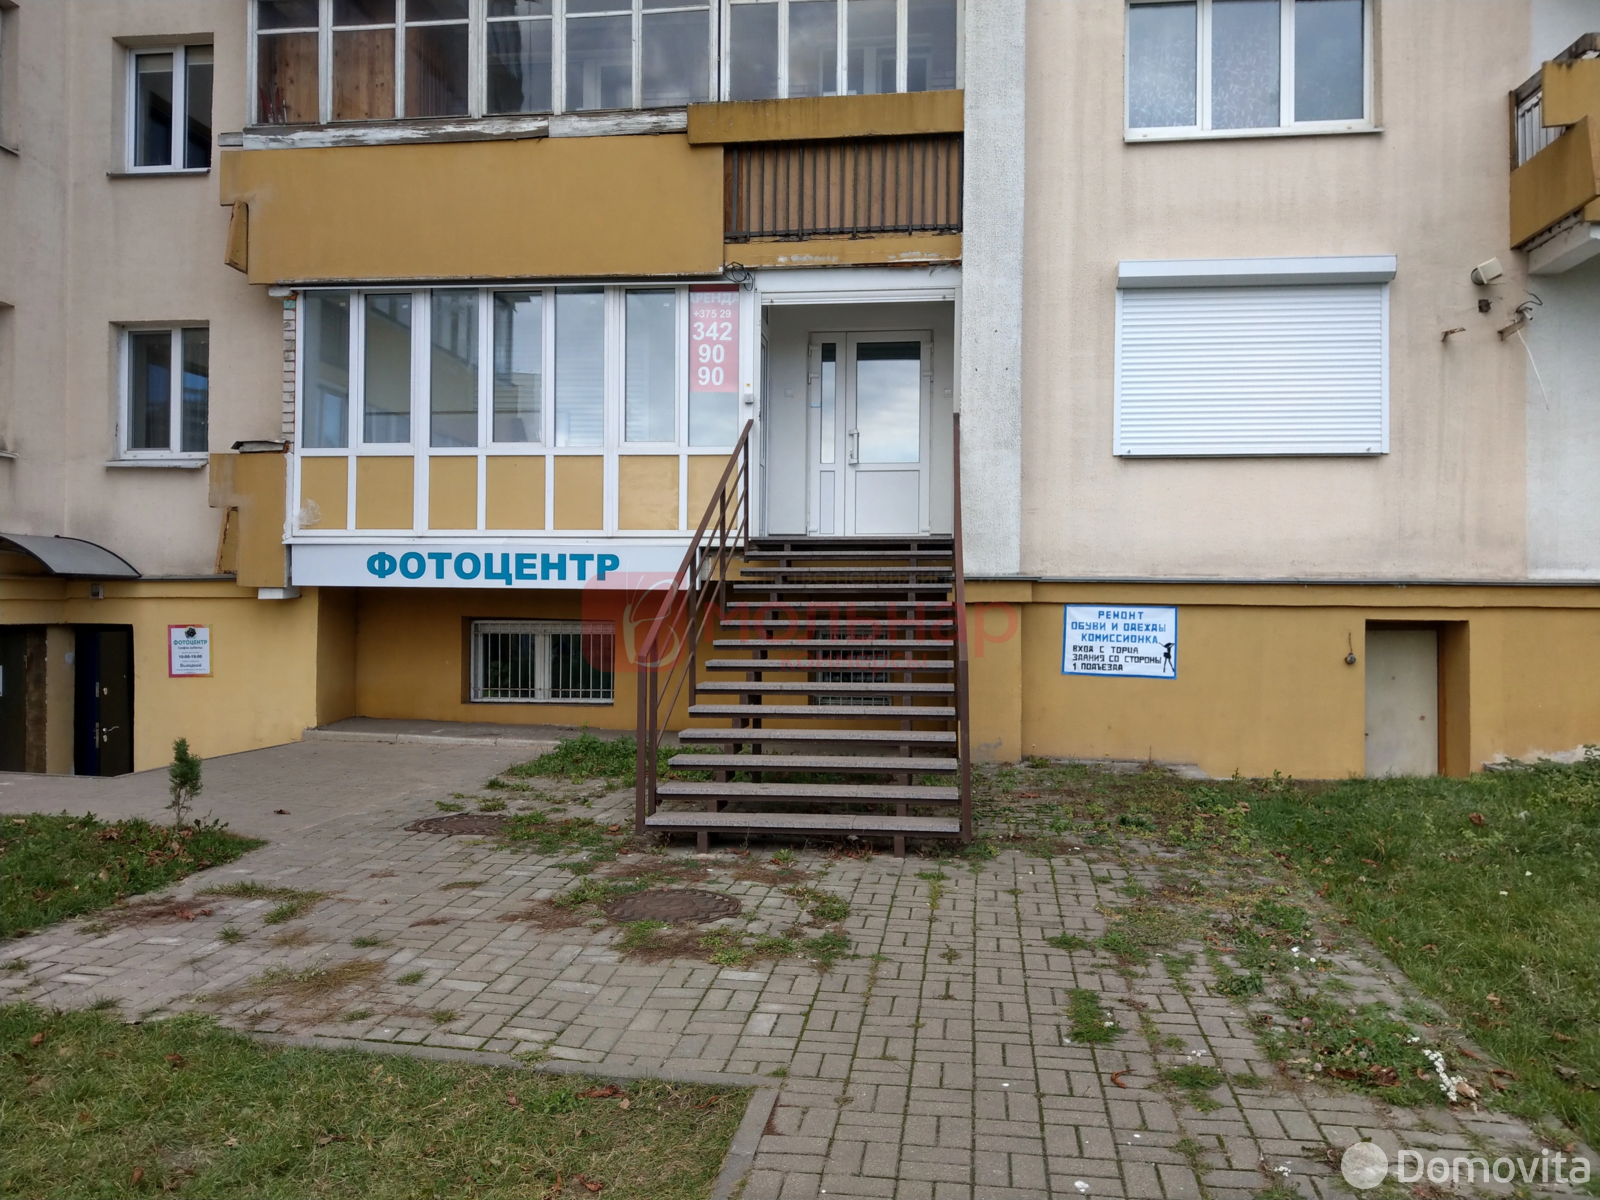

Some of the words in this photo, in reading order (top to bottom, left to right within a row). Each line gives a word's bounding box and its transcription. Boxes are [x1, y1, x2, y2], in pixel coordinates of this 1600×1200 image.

[694, 310, 716, 318] +375
[720, 310, 732, 318] 29
[692, 322, 732, 340] 342
[698, 344, 724, 364] 90
[698, 366, 724, 386] 90
[367, 552, 620, 585] ФОТОЦЕНТР
[1098, 610, 1144, 620] РЕМОНТ
[1071, 622, 1106, 631] ОБУВИ
[1112, 622, 1118, 631] И
[1123, 623, 1166, 632] ОДЕЖДЫ
[1081, 634, 1158, 644] КОМИССИОНКА
[1072, 645, 1094, 653] ВХОД
[1110, 646, 1138, 654] ТОРЦА
[1072, 654, 1105, 662] ЗДАНИЯ
[1109, 655, 1119, 663] СО
[1125, 656, 1162, 664] СТОРОНЫ
[1073, 663, 1077, 671] 1
[1081, 663, 1123, 671] ПОДЪЕЗДА
